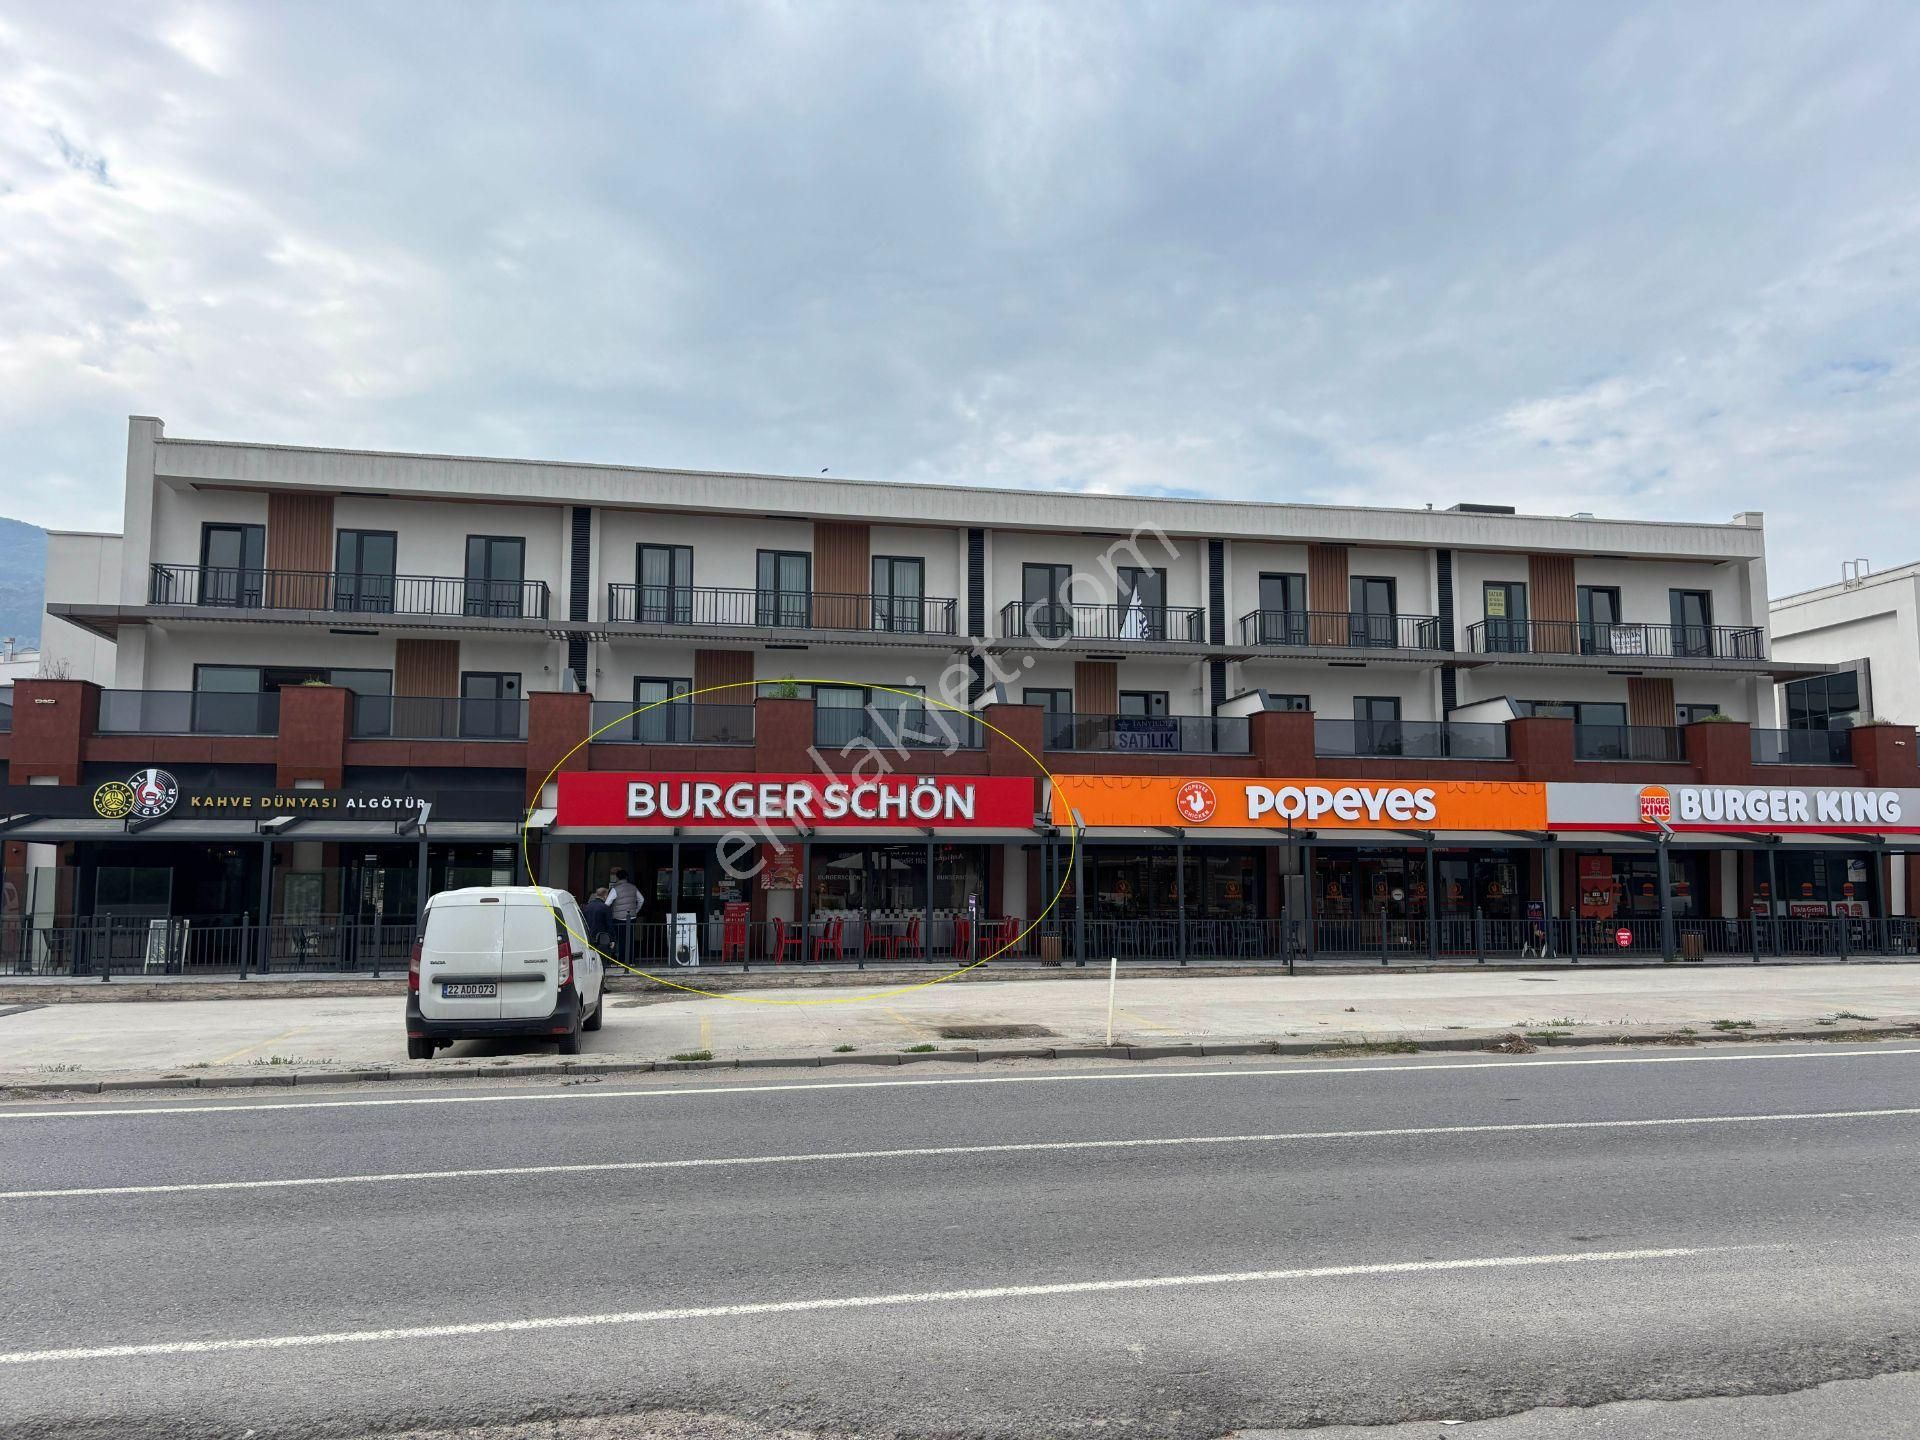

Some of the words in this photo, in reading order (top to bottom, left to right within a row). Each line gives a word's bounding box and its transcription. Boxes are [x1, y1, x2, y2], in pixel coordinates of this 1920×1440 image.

[1119, 733, 1174, 748] SATILIK
[130, 776, 145, 789] AL
[98, 784, 130, 797] KAHVE
[191, 796, 252, 807] KAHVE
[262, 794, 338, 808] DÜNYASI
[346, 796, 426, 808] ALGÖTÜR
[1641, 797, 1670, 805] BURGER
[1679, 788, 1810, 822] BURGER
[1816, 790, 1902, 823] KING
[1641, 805, 1670, 816] KING
[448, 984, 459, 994] 22
[478, 984, 495, 994] 073
